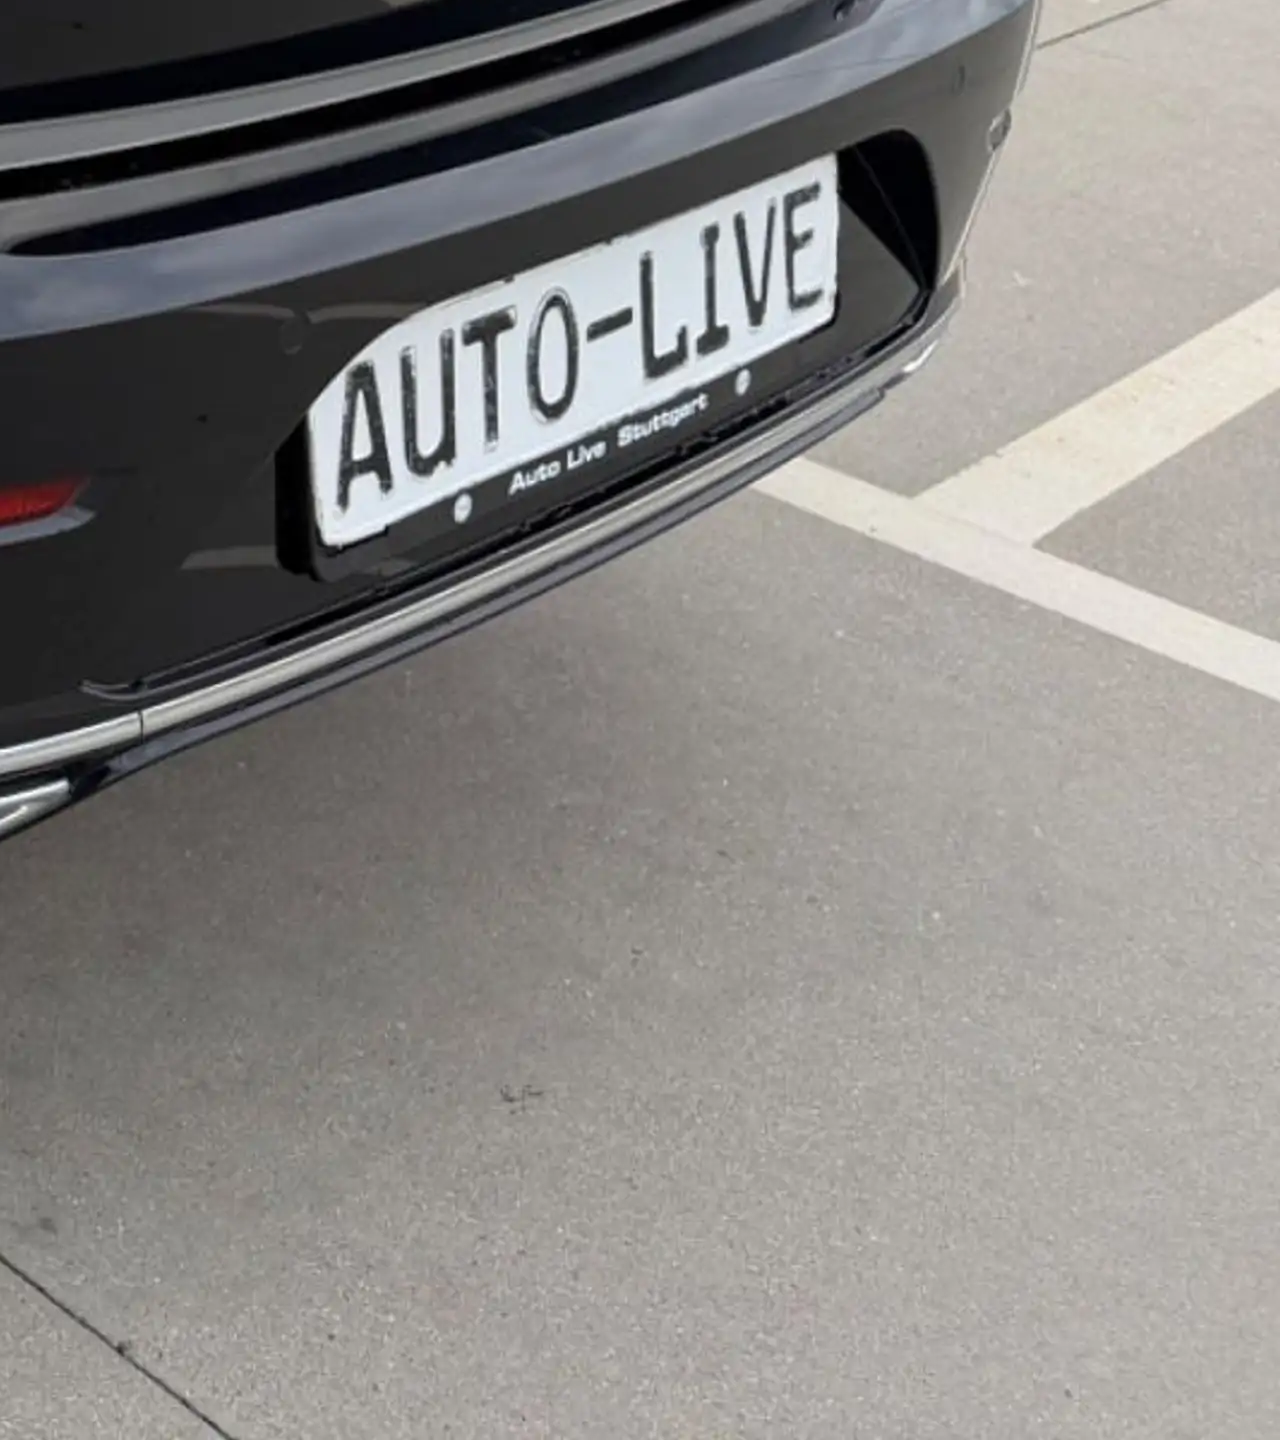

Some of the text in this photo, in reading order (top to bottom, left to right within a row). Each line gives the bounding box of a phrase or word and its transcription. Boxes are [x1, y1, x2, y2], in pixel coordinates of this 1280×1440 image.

[336, 182, 822, 514] AUTO-LIVE
[509, 393, 708, 495] Auto Live Stuttgart
